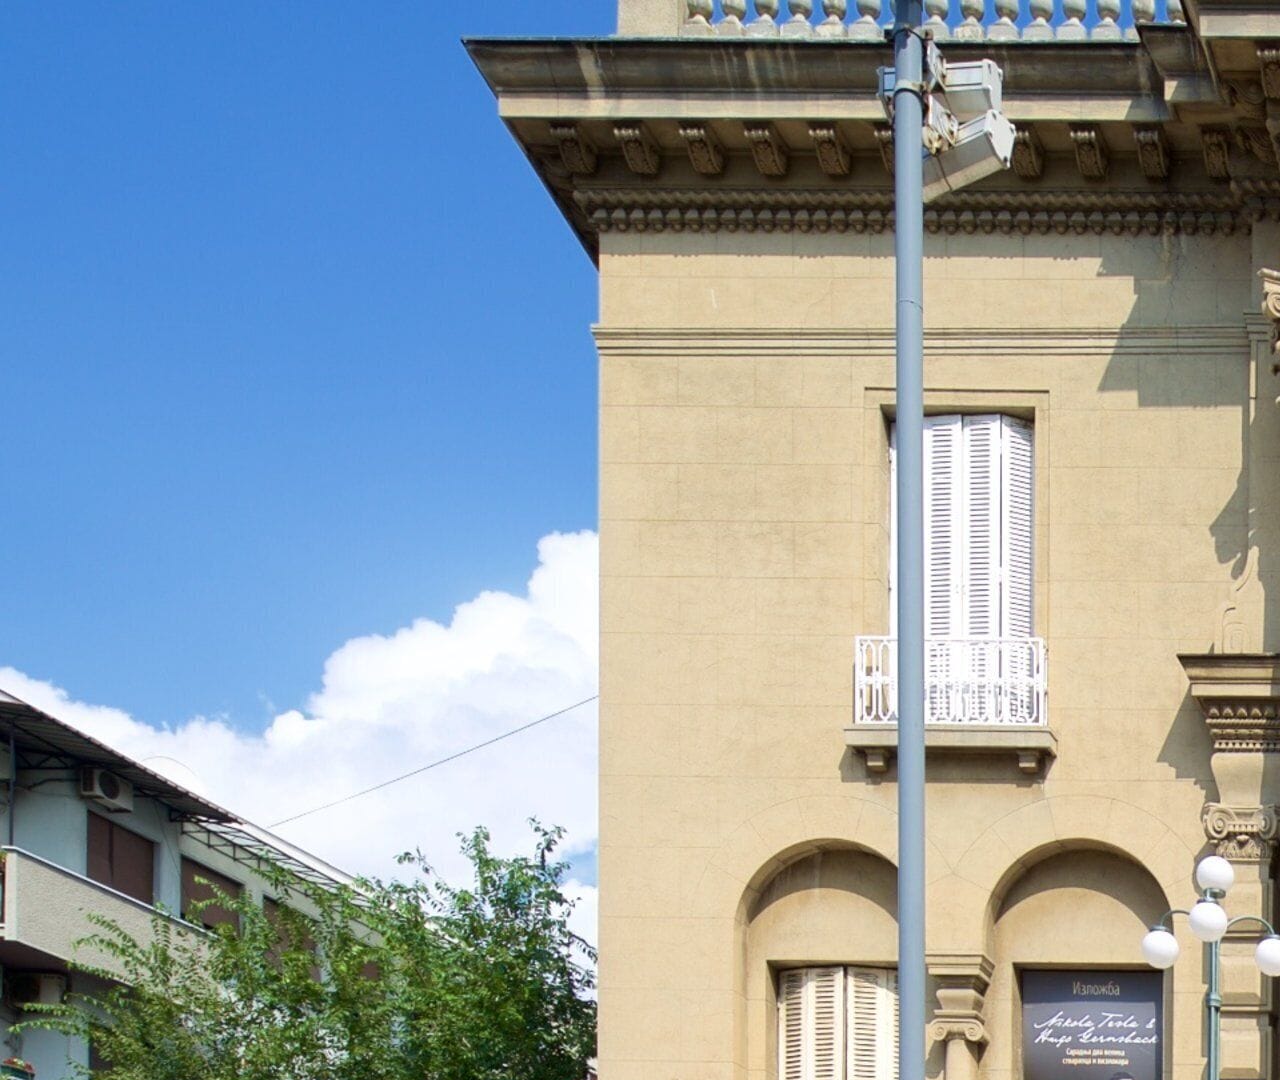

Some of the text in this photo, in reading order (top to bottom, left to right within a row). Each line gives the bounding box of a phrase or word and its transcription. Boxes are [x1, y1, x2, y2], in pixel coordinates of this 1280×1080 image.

[1073, 981, 1120, 995] Изложба
[1033, 1011, 1094, 1029] Nikola
[1098, 1012, 1139, 1028] Tesla
